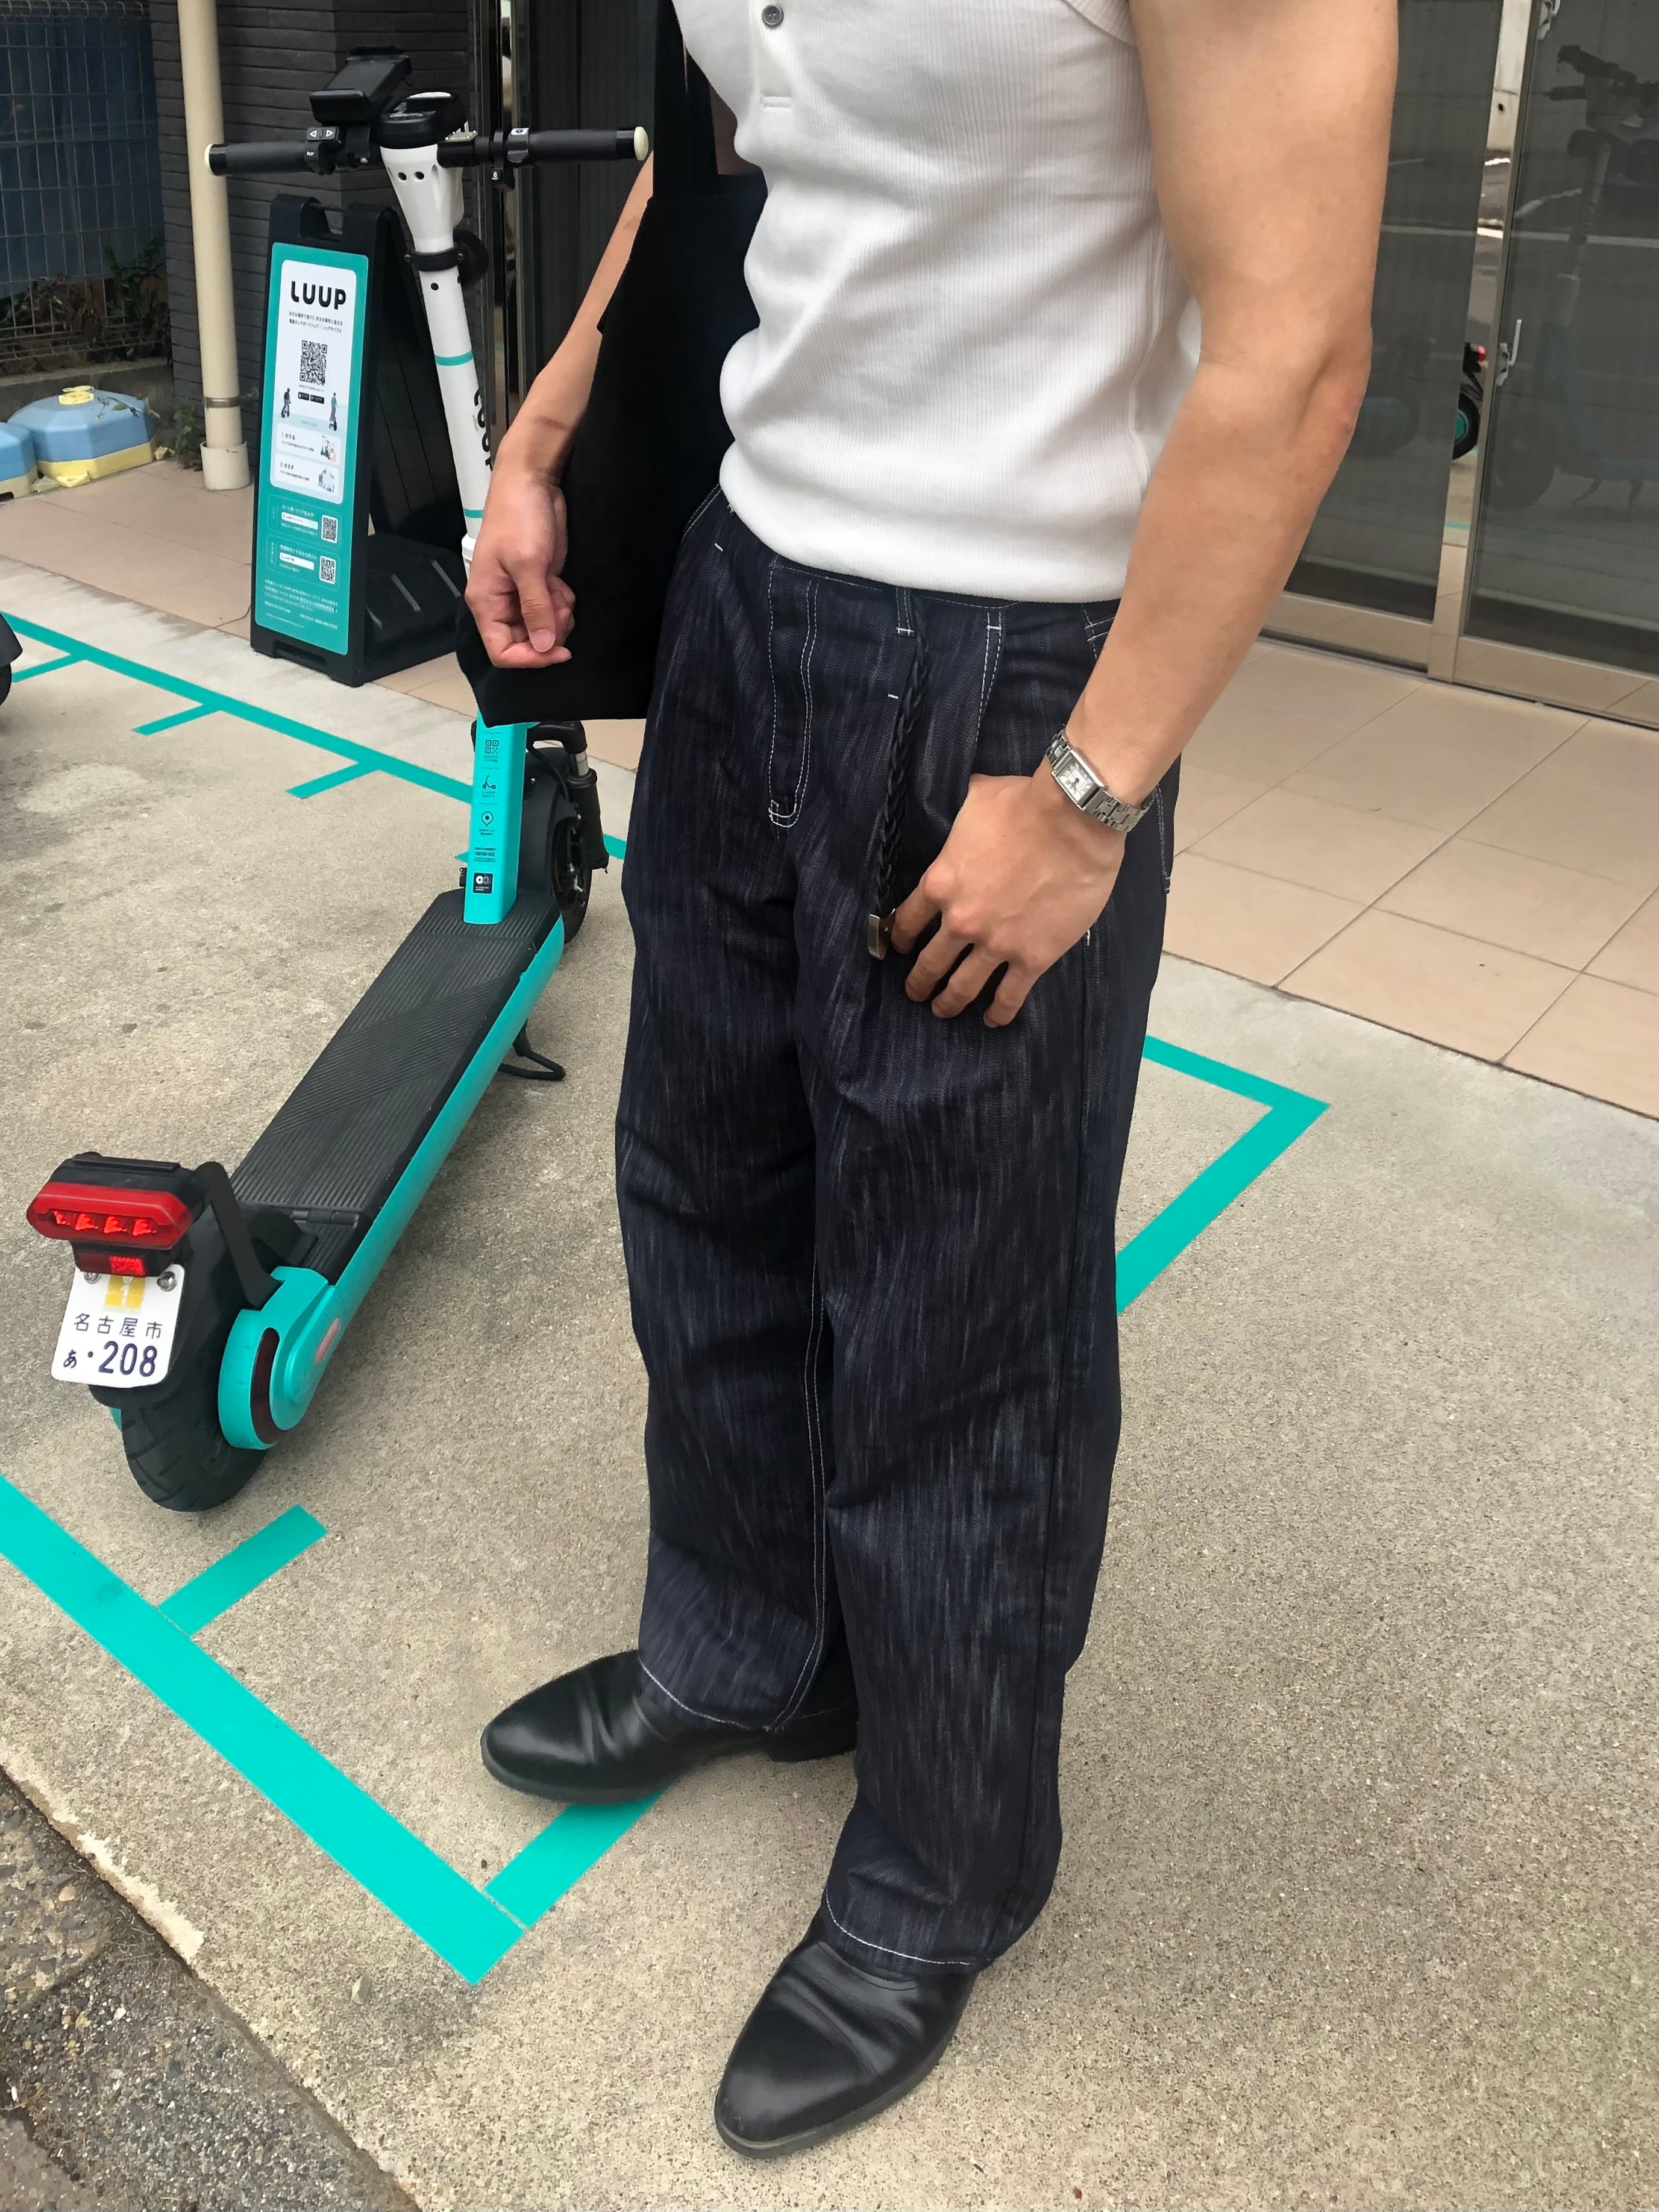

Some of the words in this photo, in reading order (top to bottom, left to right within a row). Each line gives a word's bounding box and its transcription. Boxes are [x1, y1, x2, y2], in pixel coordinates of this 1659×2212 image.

[291, 281, 346, 310] LUUP
[74, 1313, 163, 1339] 名古屋市
